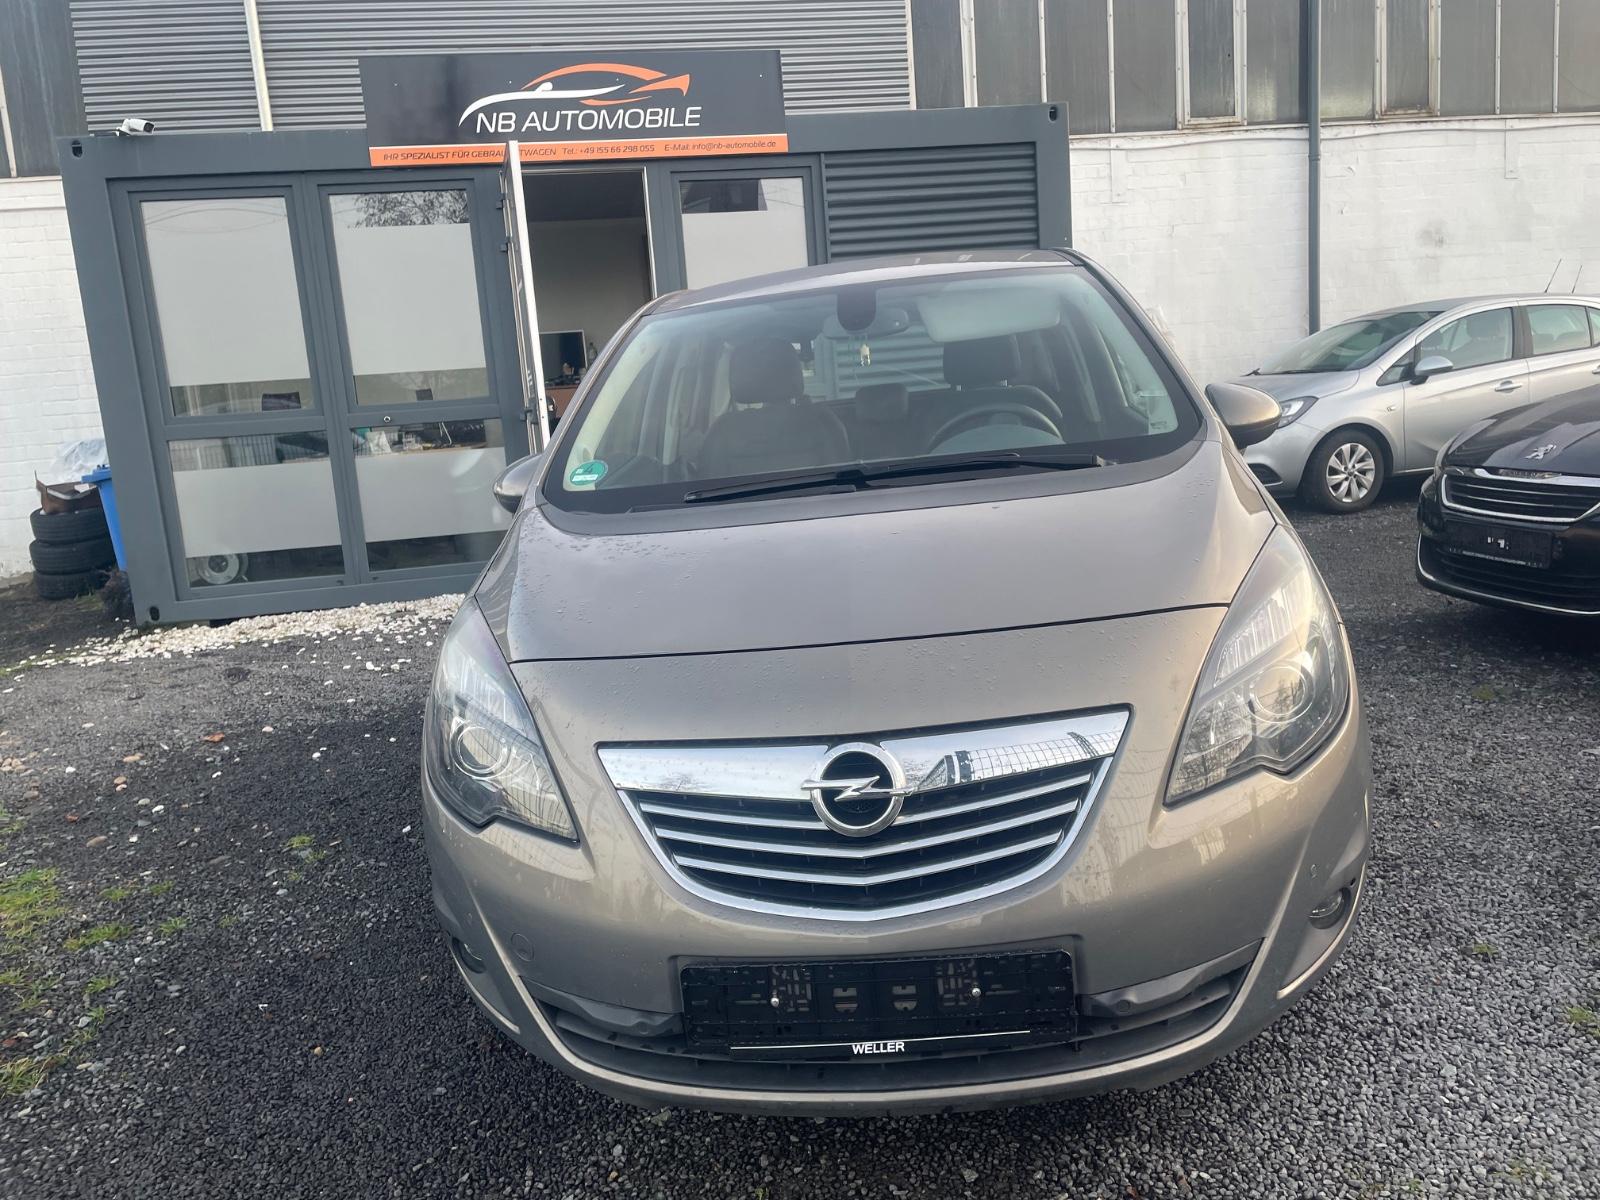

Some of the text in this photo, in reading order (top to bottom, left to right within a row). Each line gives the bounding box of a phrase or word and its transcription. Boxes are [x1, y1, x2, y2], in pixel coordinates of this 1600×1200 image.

[476, 106, 702, 134] NB AUTOMOBILE
[383, 152, 399, 161] IHR
[400, 151, 450, 160] SPEZIALIST
[451, 149, 470, 159] FÜR
[579, 146, 595, 155] +49
[610, 145, 621, 153] 66
[622, 144, 638, 153] 298
[639, 144, 655, 153] 055
[691, 140, 777, 151] info@nb-automobile.de
[851, 1041, 904, 1054] WELLER
